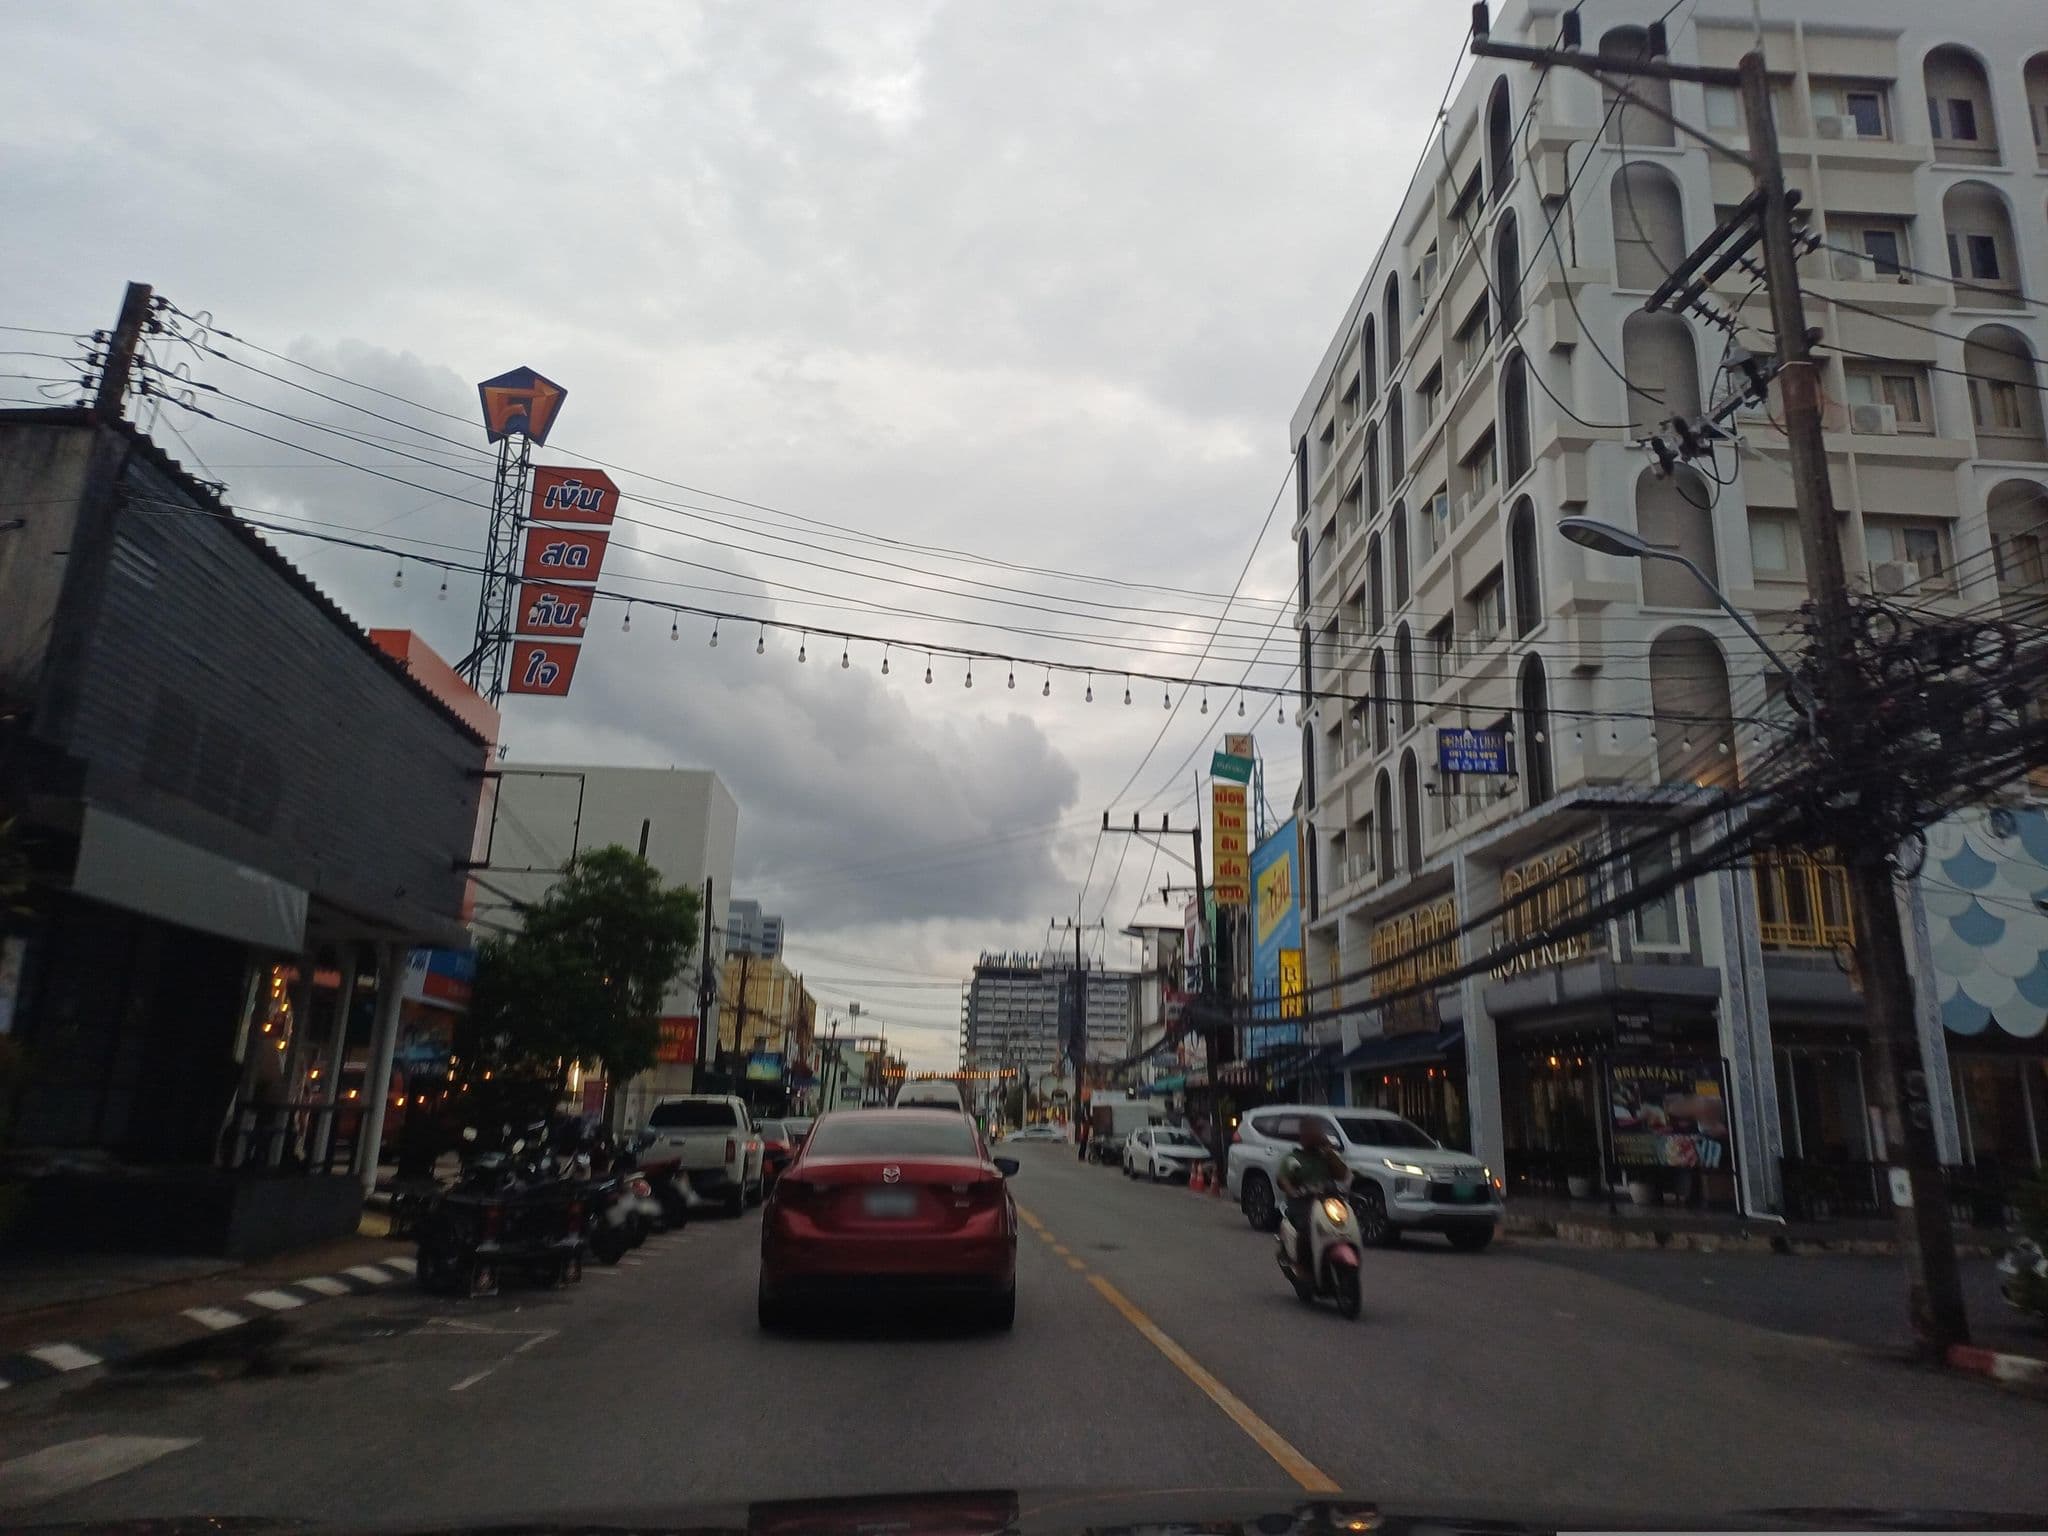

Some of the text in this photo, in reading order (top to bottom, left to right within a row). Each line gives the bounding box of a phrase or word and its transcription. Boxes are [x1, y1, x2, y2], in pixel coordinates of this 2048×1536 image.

[544, 480, 605, 513] เงิน
[539, 543, 590, 569] สด
[523, 650, 560, 688] ใจ
[1613, 1064, 1685, 1083] BREAKFAST
